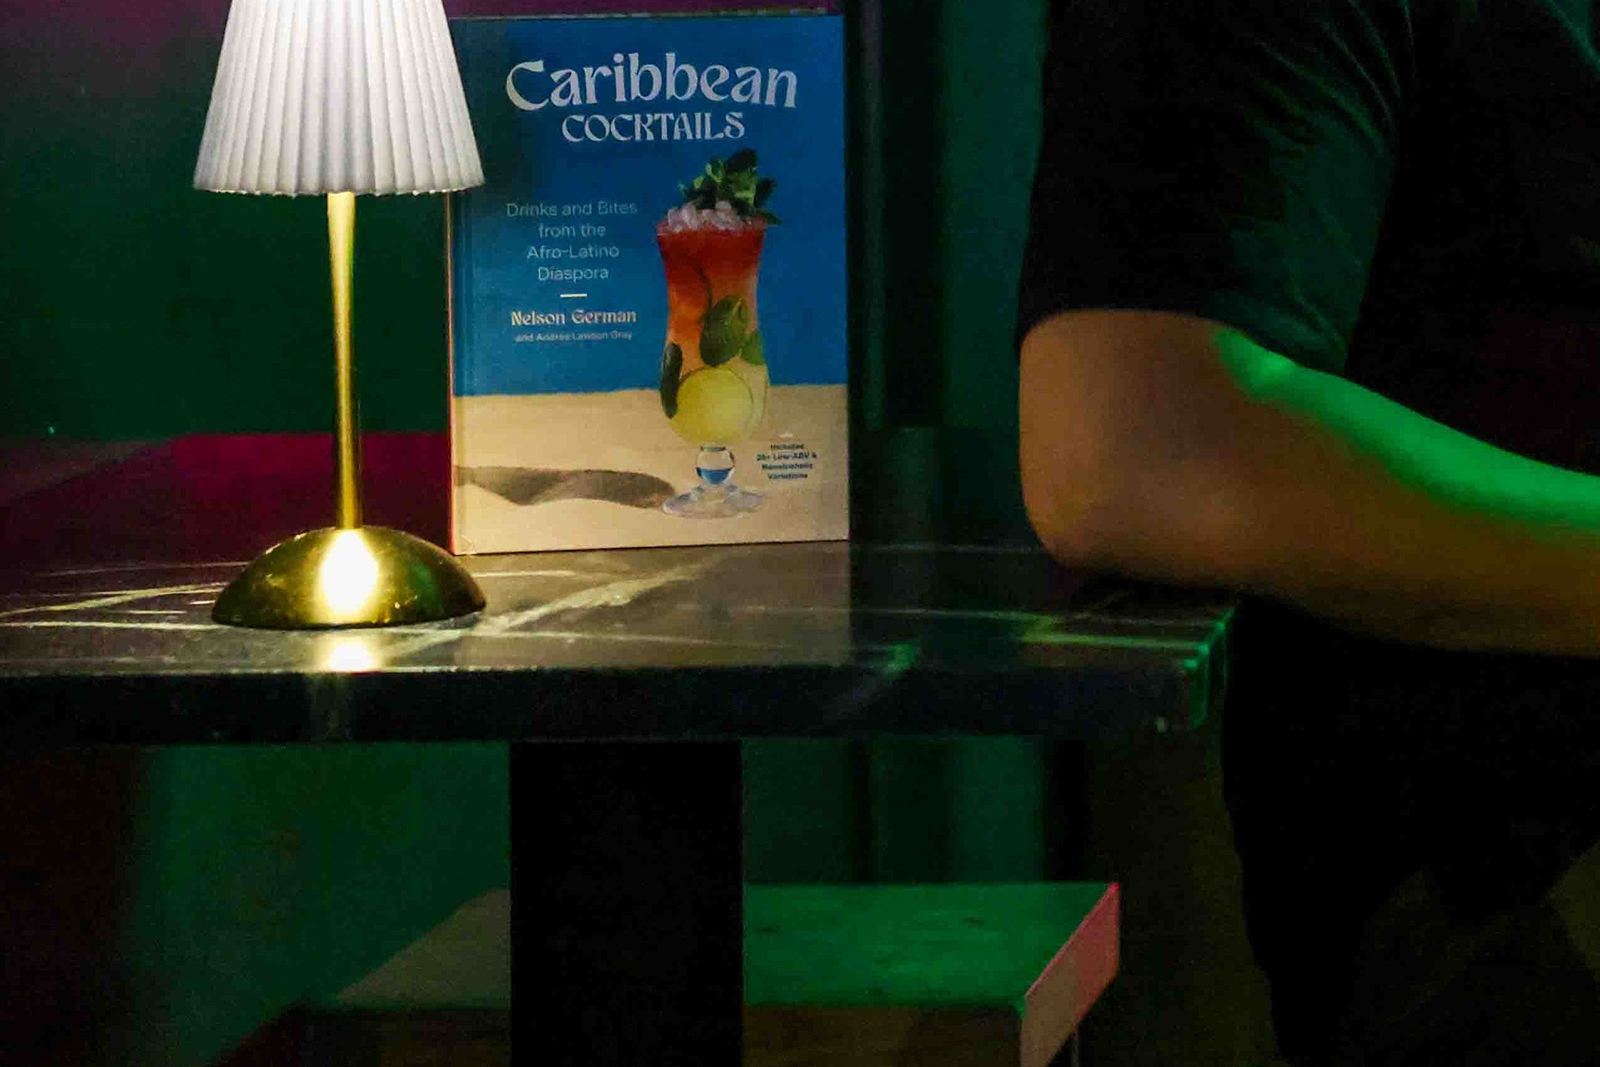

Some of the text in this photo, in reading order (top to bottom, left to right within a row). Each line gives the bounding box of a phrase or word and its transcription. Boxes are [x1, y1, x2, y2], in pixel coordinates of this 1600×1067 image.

[506, 52, 798, 111] Caribbean
[561, 112, 746, 143] COCKTAILS
[506, 200, 638, 217] Drinks and Bites
[538, 222, 607, 238] from the
[527, 244, 620, 259] Afro-Latino
[537, 266, 609, 282] Diaspora
[511, 308, 637, 326] Nelson German
